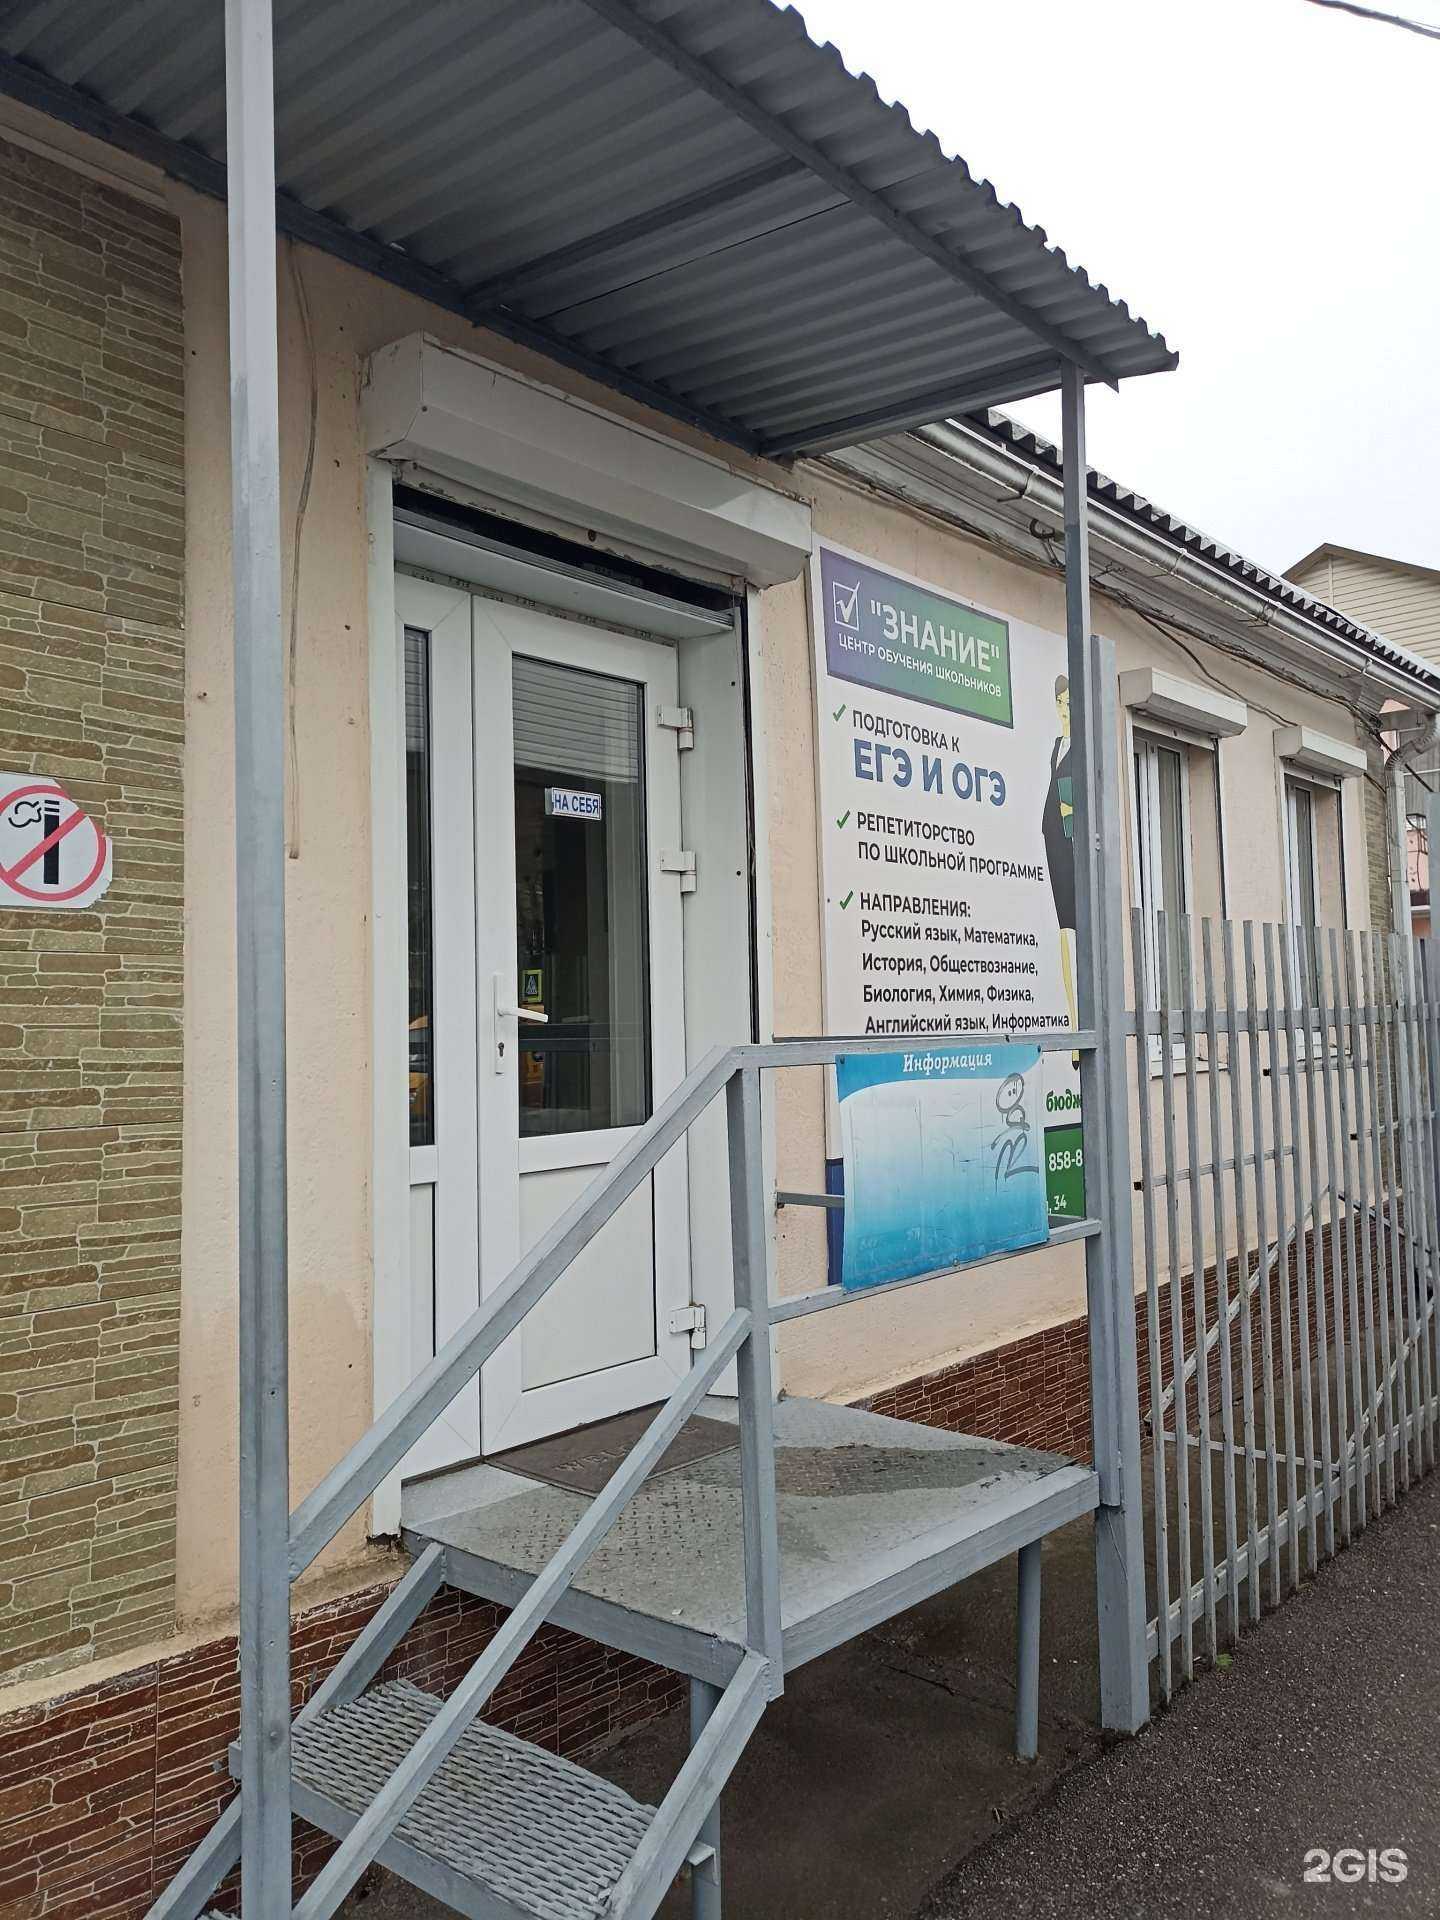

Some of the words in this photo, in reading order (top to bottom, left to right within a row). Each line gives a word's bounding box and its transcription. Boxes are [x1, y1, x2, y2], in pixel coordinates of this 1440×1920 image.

[870, 599, 1000, 672] "ЗНАНИЕ"
[838, 633, 875, 656] ЦЕНТР
[877, 646, 933, 675] ОБУЧЕНИЯ
[935, 666, 1002, 697] ШКОЛЬНИКОВ
[852, 709, 948, 749] ПОДГОТОВКА
[951, 736, 960, 753] К
[853, 738, 913, 787] ЕГЭ
[922, 754, 943, 795] И
[952, 762, 1007, 807] ОГЭ
[554, 793, 569, 810] НА
[571, 795, 599, 814] СЕБЯ
[857, 811, 975, 846] РЕПЕТИТОРСТВО
[858, 841, 880, 861] ПО
[884, 844, 966, 872] ШКОЛЬНОЙ
[969, 856, 1044, 882] ПРОГРАММЕ
[860, 891, 971, 918] НАПРАВЛЕНИЯ:
[861, 919, 921, 942] Русский
[924, 925, 961, 944] язык,
[964, 927, 1039, 947] Математика,
[862, 953, 927, 976] История,
[929, 955, 1038, 976] Обществознание,
[863, 984, 936, 1004] Биология,
[939, 985, 984, 1004] Химия,
[986, 984, 1035, 1003] Физика,
[865, 1013, 951, 1034] Английский
[955, 1016, 989, 1032] язык,
[992, 1012, 1070, 1033] Информатика
[903, 1053, 993, 1076] Информация
[1053, 1194, 1067, 1211] 34
